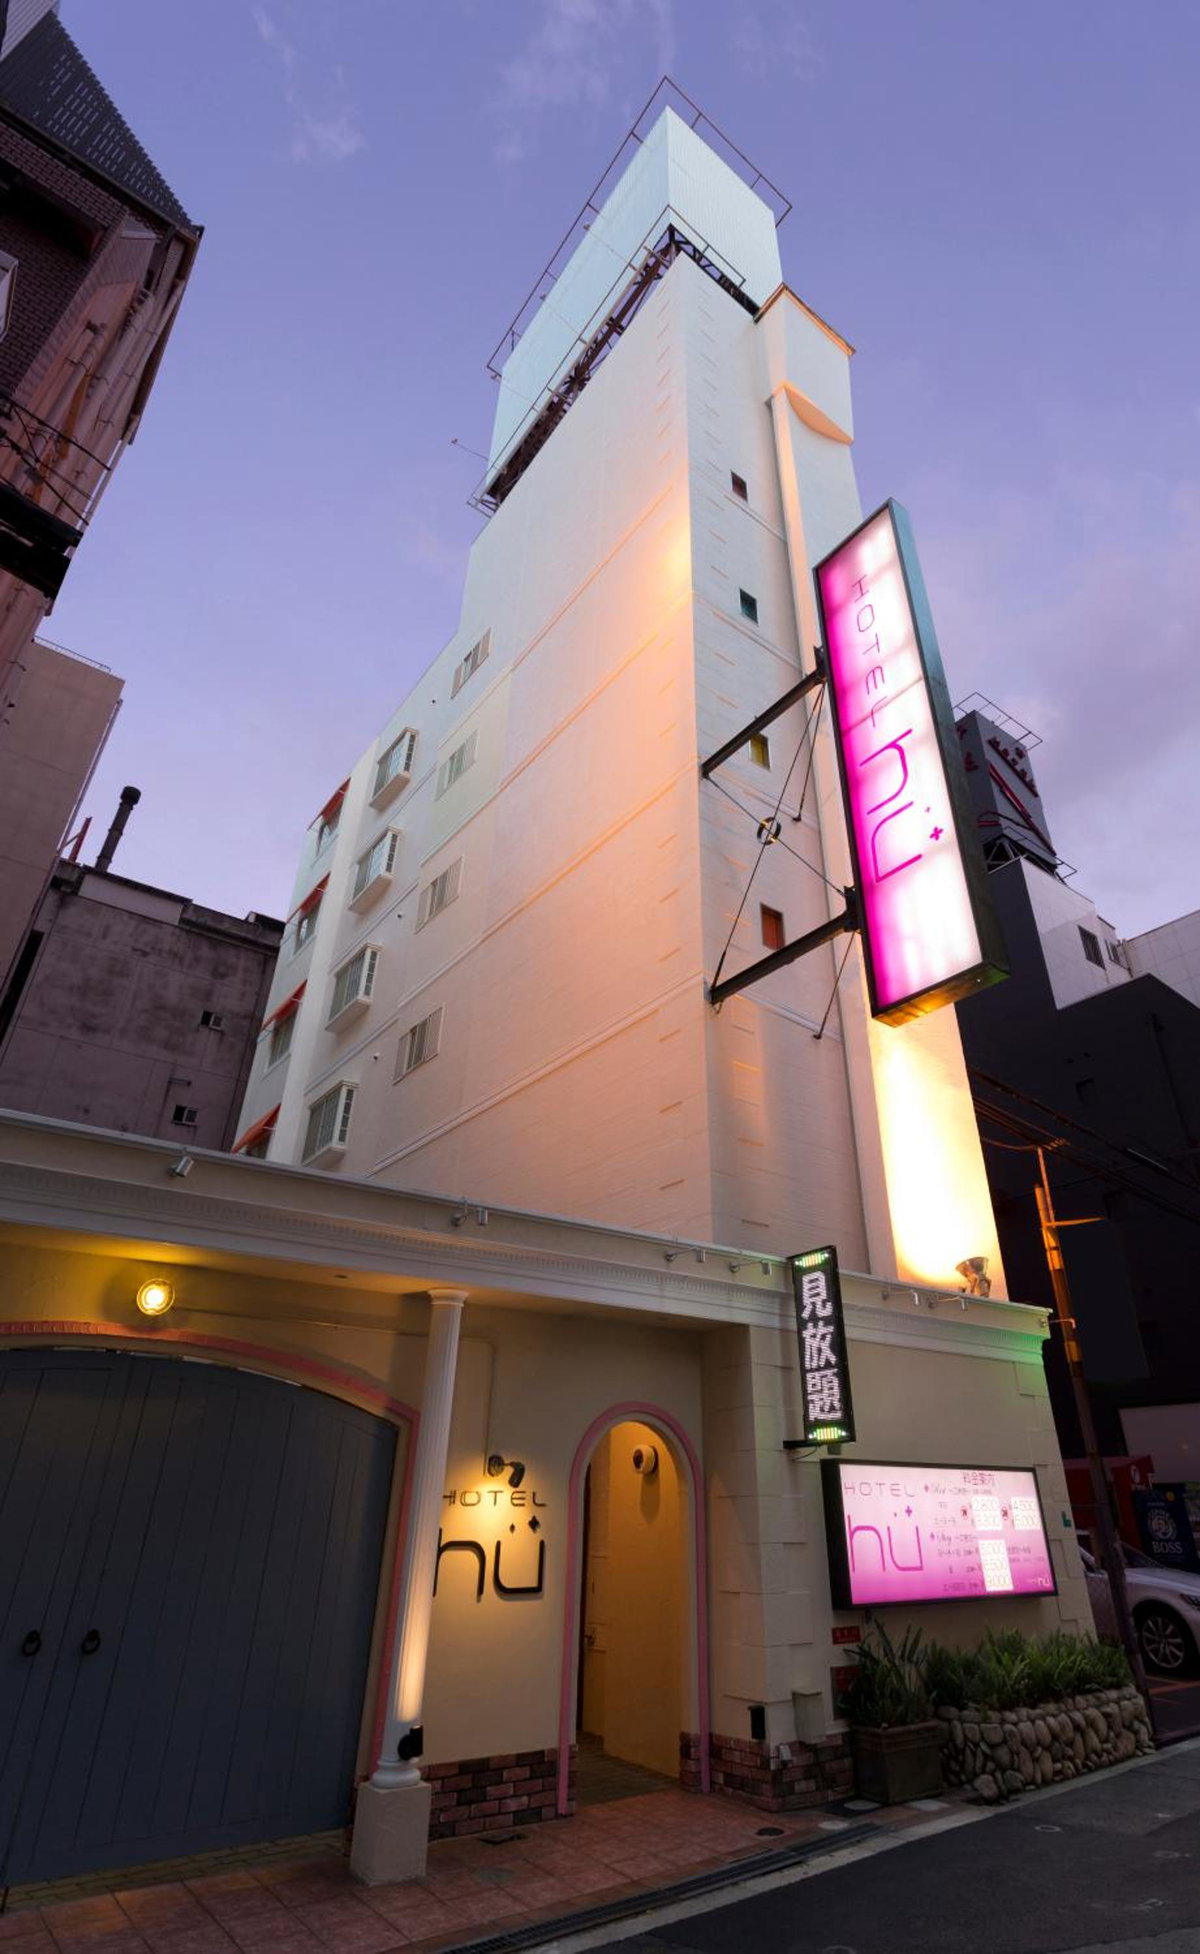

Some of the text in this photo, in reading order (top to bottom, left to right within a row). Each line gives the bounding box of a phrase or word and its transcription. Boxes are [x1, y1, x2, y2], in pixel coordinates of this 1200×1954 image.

[852, 574, 887, 728] HOTEL
[801, 1270, 842, 1421] 見放題
[443, 1489, 548, 1508] HOTEL
[844, 1481, 916, 1497] HOTEL
[1152, 1541, 1183, 1554] BOSS
